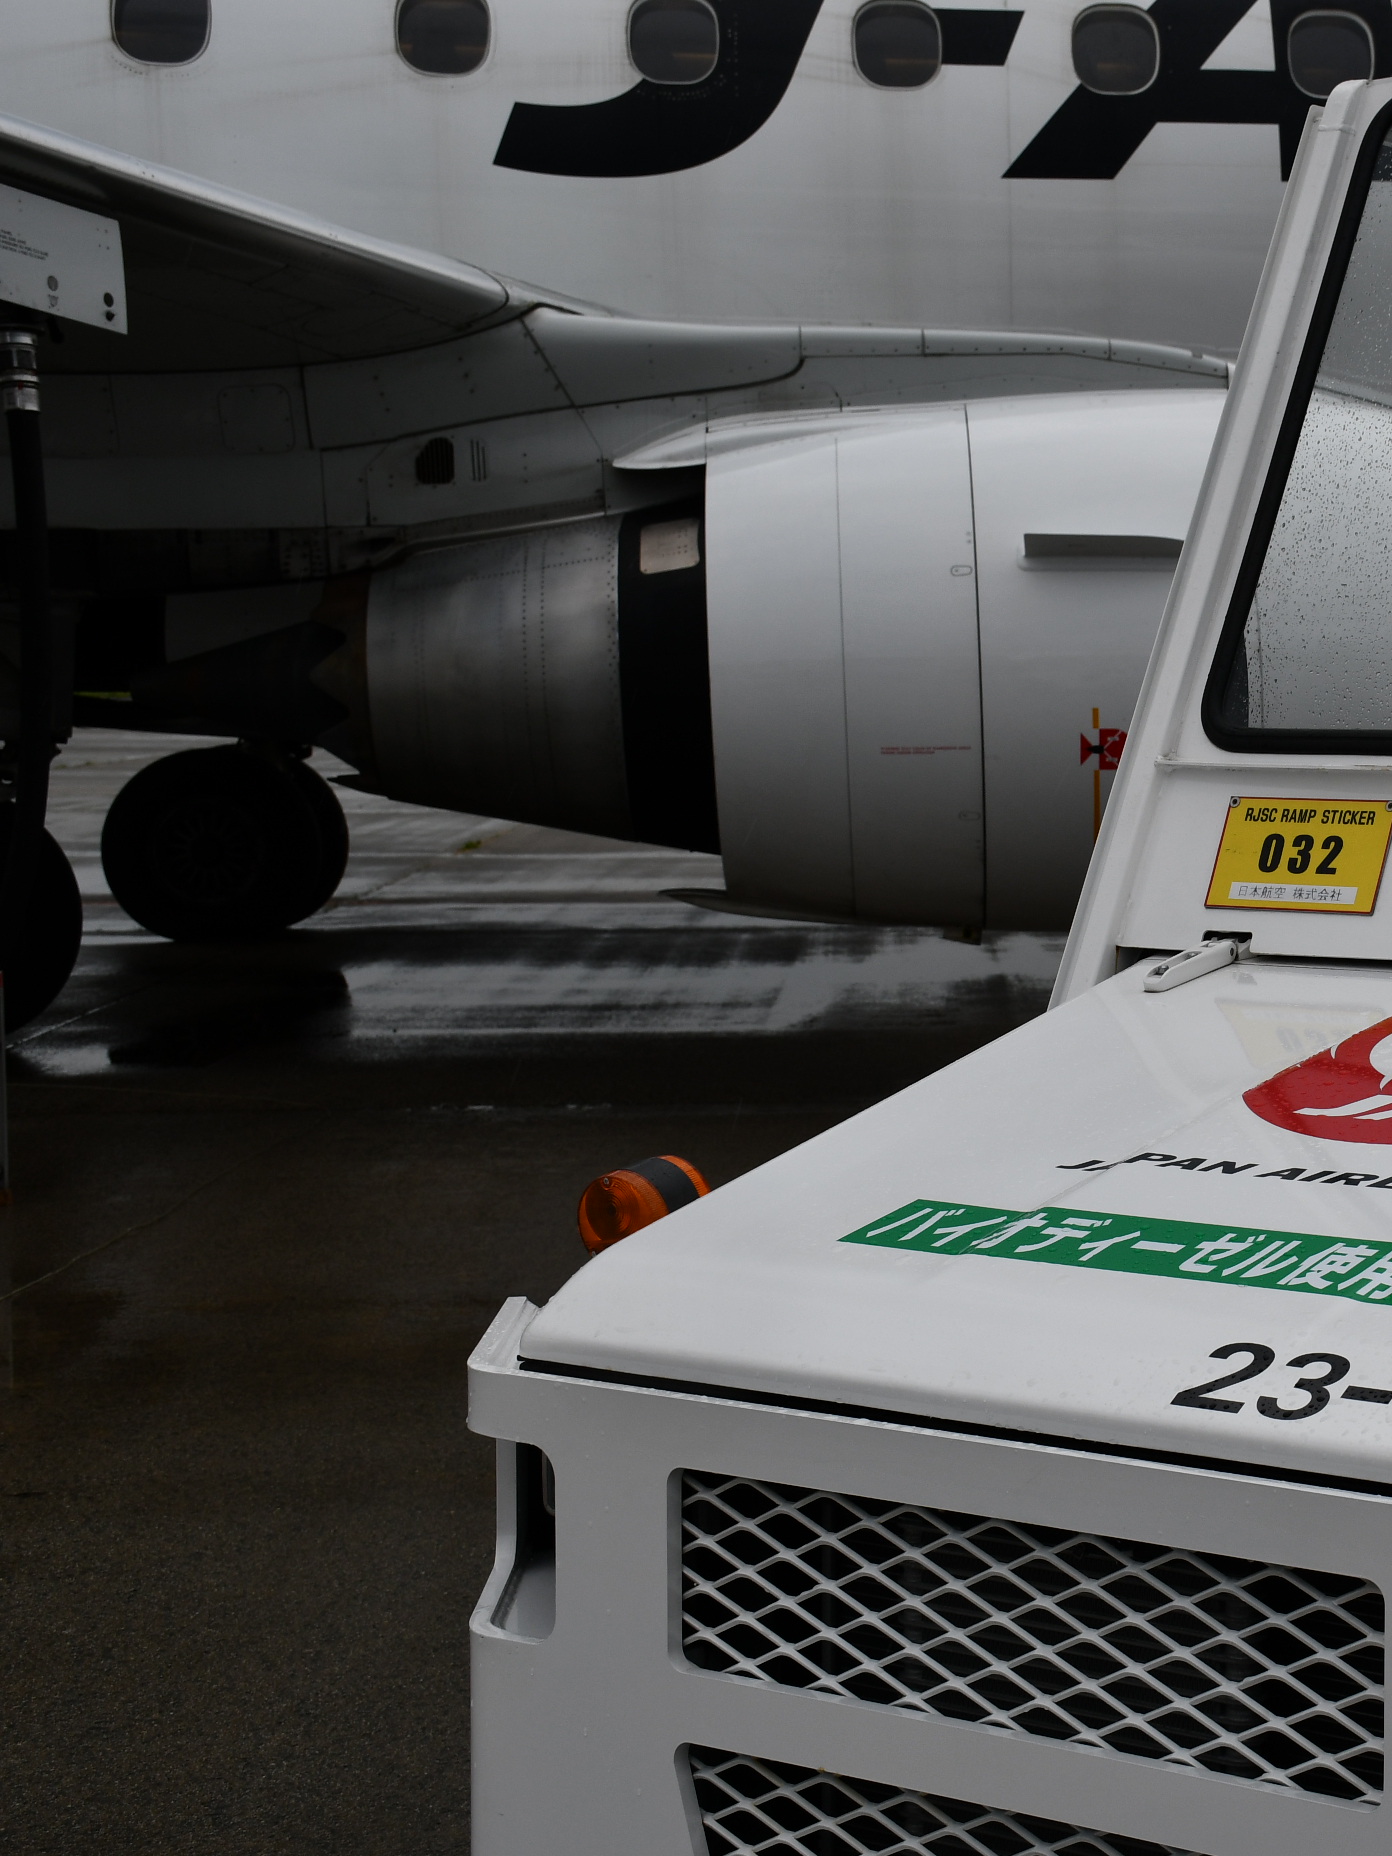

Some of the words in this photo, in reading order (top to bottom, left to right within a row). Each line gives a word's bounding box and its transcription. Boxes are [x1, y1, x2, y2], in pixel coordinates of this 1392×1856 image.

[1245, 808, 1277, 823] RJSC
[1280, 809, 1317, 824] RAMP
[1321, 810, 1376, 826] STICKER
[1258, 833, 1344, 875] 032
[1238, 885, 1286, 899] 日本航空
[1293, 887, 1343, 902] 株式会社
